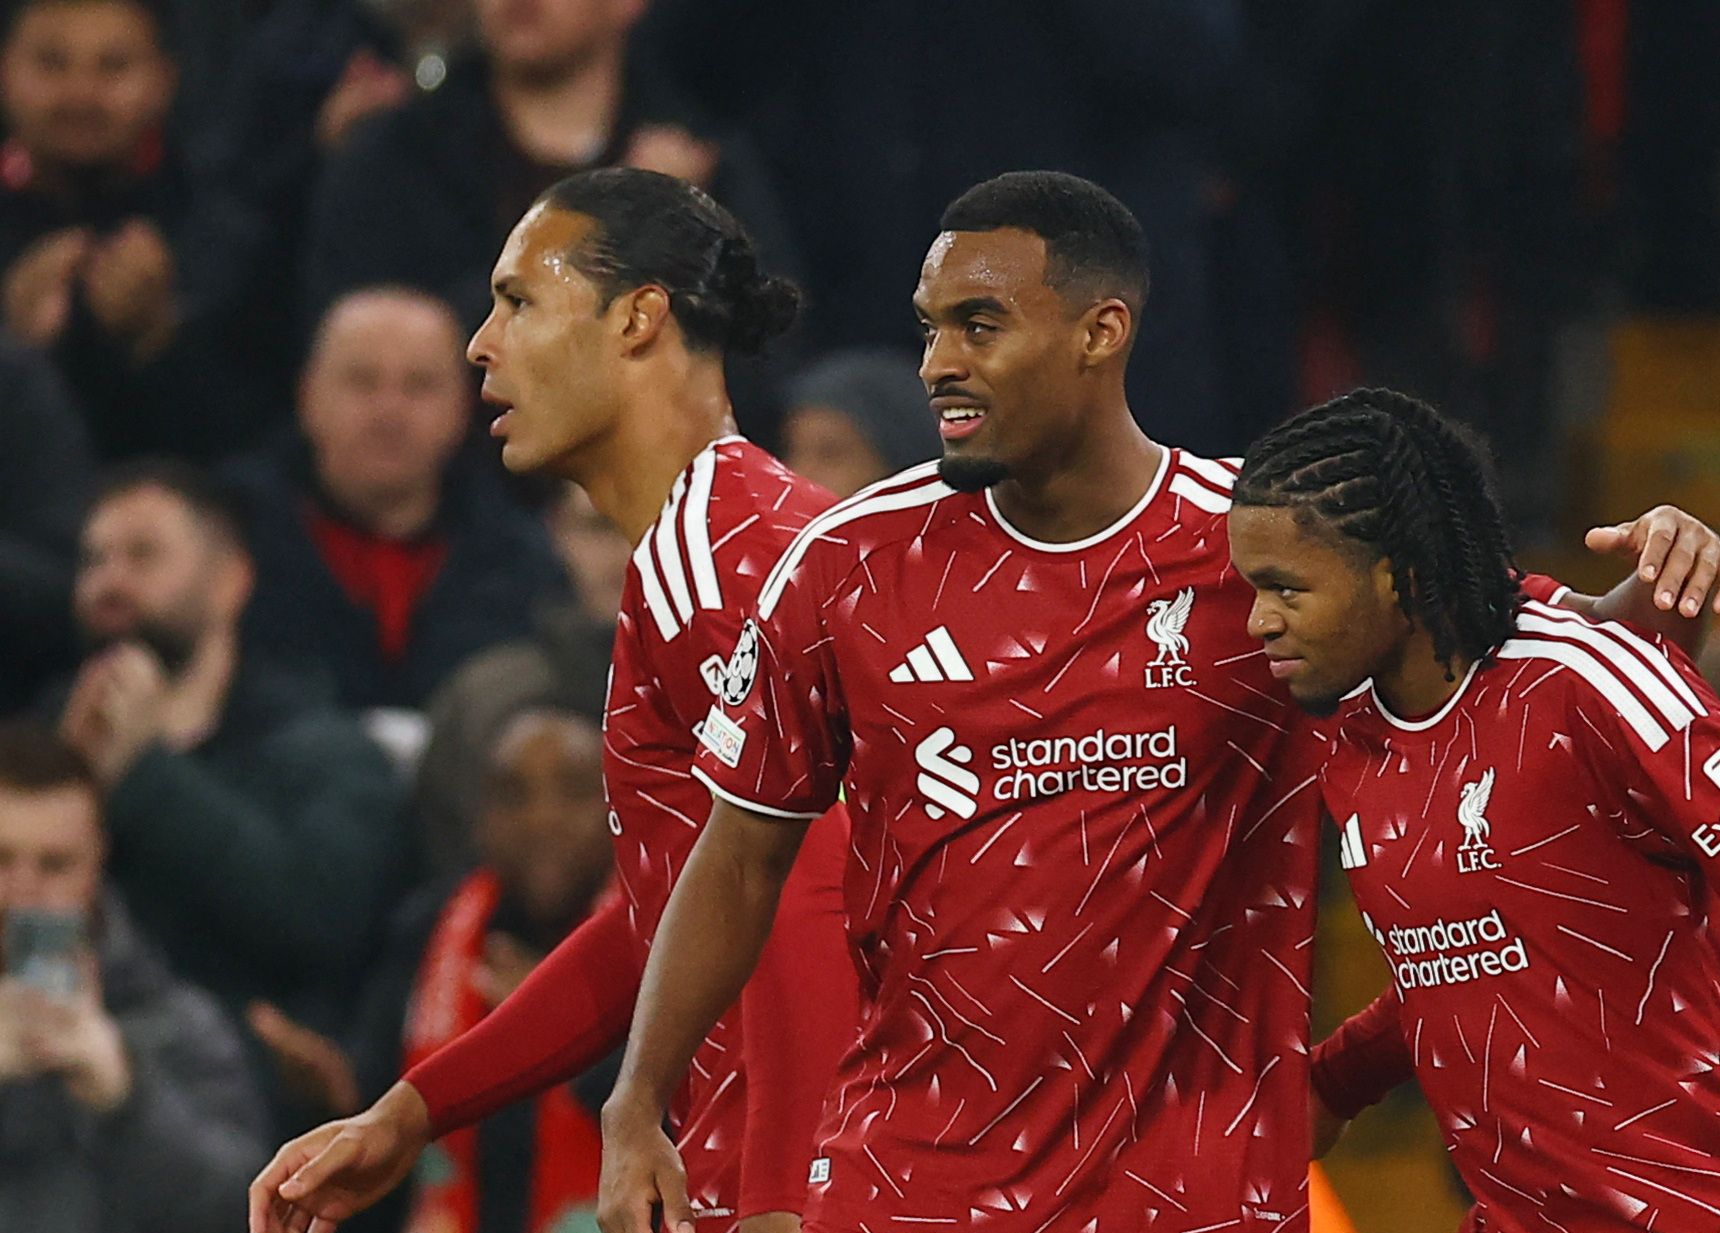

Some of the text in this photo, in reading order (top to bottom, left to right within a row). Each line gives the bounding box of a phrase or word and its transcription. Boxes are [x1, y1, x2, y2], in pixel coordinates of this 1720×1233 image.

[1145, 665, 1196, 689] L.F.C.
[992, 726, 1176, 769] standard
[993, 757, 1186, 800] chartered
[1457, 852, 1501, 873] L.F.C.
[1388, 909, 1507, 953] standard
[1398, 939, 1529, 989] chartered
